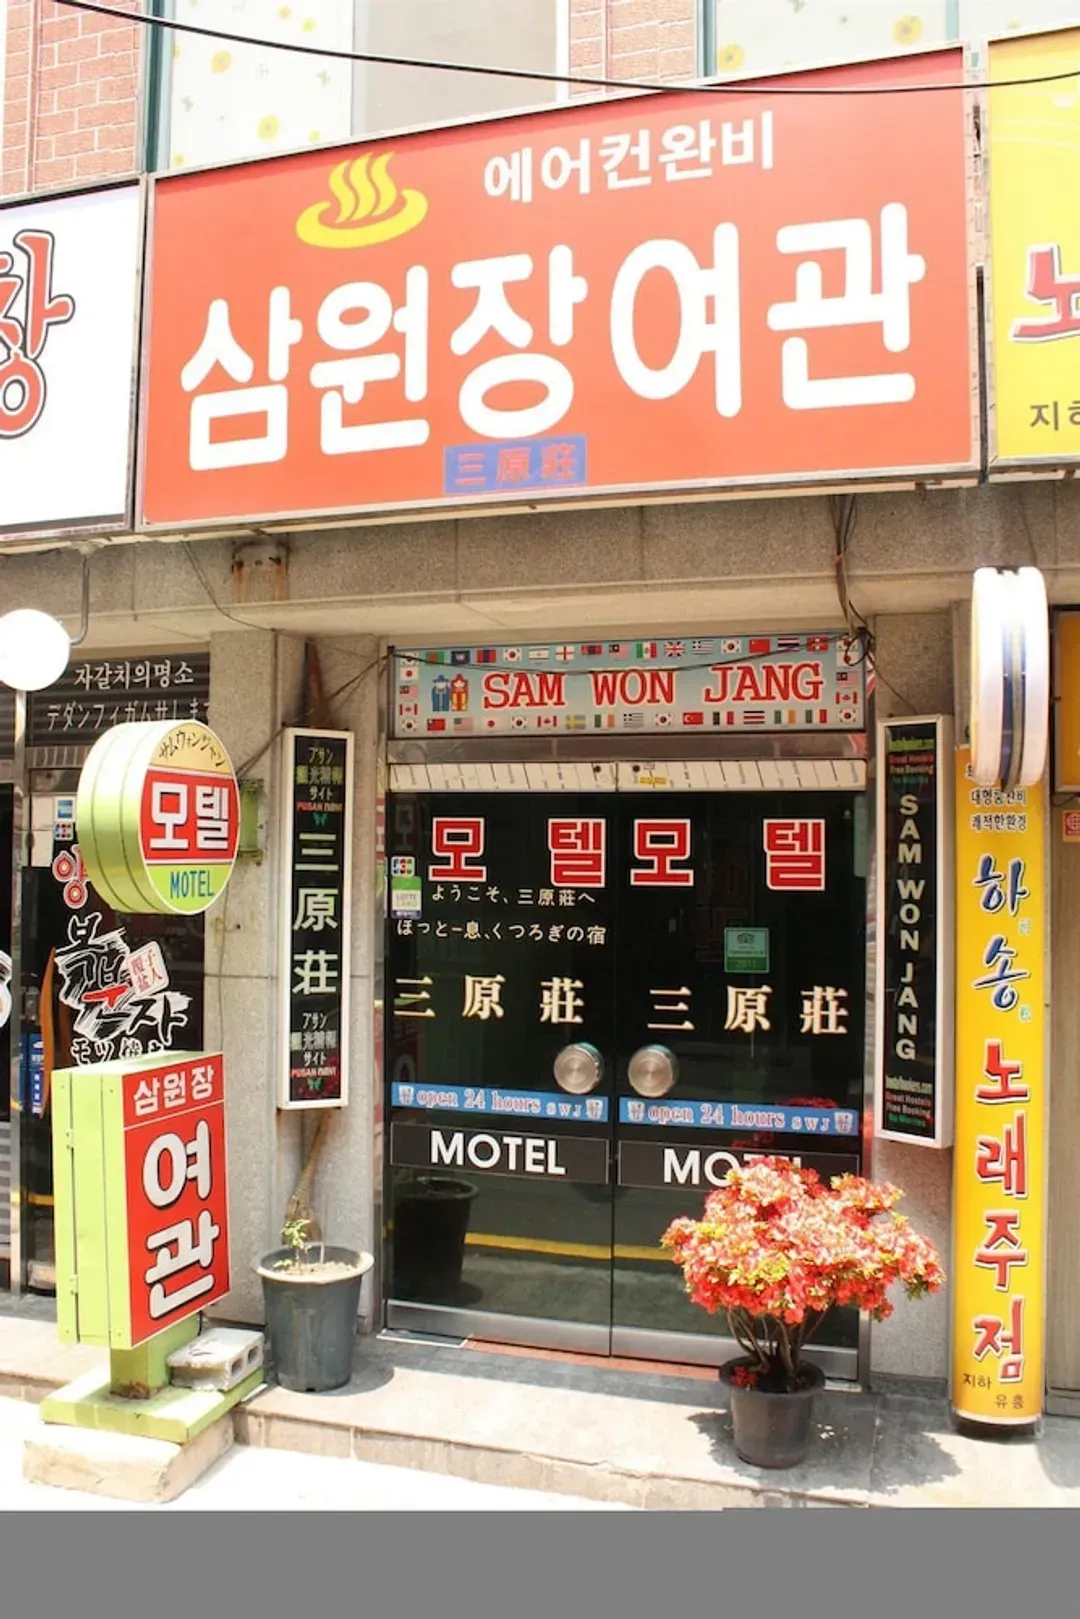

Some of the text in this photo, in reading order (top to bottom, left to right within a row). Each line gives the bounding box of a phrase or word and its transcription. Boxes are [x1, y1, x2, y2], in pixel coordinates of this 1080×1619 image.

[484, 111, 774, 203] 에어컨완비
[181, 202, 925, 471] 삼원장여관
[482, 661, 826, 710] SAM WON JANG
[149, 781, 229, 851] 모텔
[898, 793, 922, 864] SAM
[169, 869, 215, 900] MOTEL
[896, 879, 926, 951] WON
[895, 962, 919, 1061] JANG
[132, 1065, 215, 1116] 삼원장
[416, 1088, 459, 1110] open
[463, 1088, 486, 1109] 24
[491, 1090, 542, 1114] hours
[647, 1104, 695, 1125] open
[699, 1103, 725, 1125] 24
[731, 1104, 786, 1129] hours
[430, 1130, 567, 1176] MOTEL
[142, 1119, 220, 1318] 여관
[974, 1038, 1031, 1384] 노래주점
[963, 1373, 992, 1391] 지하
